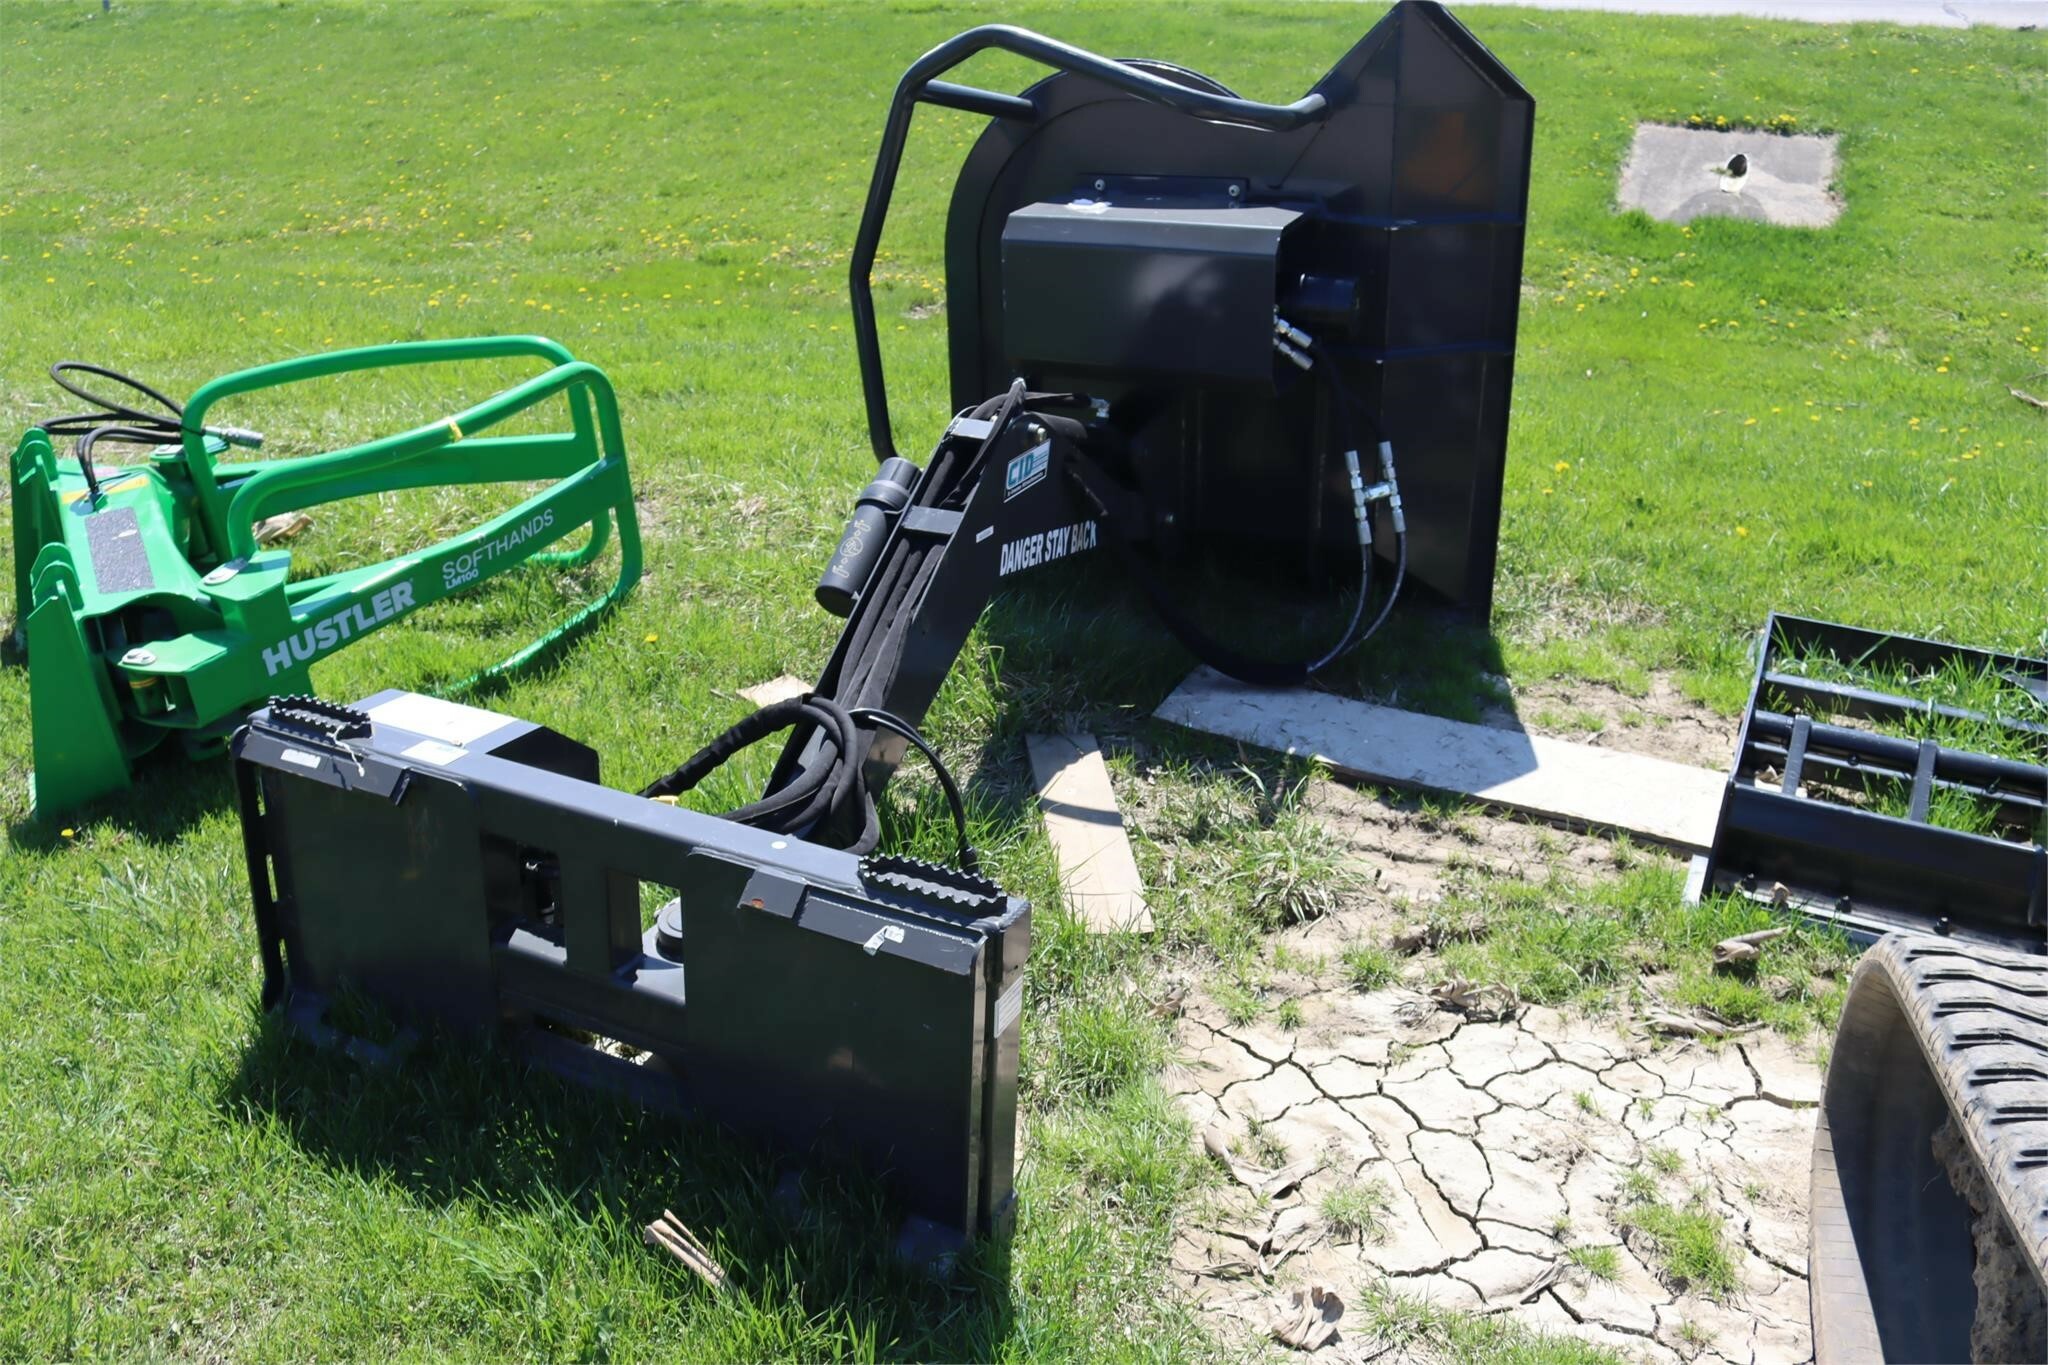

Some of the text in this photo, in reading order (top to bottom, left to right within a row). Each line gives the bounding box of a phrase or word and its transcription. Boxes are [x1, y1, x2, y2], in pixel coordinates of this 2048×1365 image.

[1008, 452, 1034, 487] CID
[442, 508, 554, 580] SOFTHANDS
[999, 533, 1044, 577] DANGER
[1045, 525, 1071, 562] STAY
[1070, 520, 1097, 554] BACK
[445, 568, 479, 590] LM100
[262, 581, 416, 677] HUSTLER
